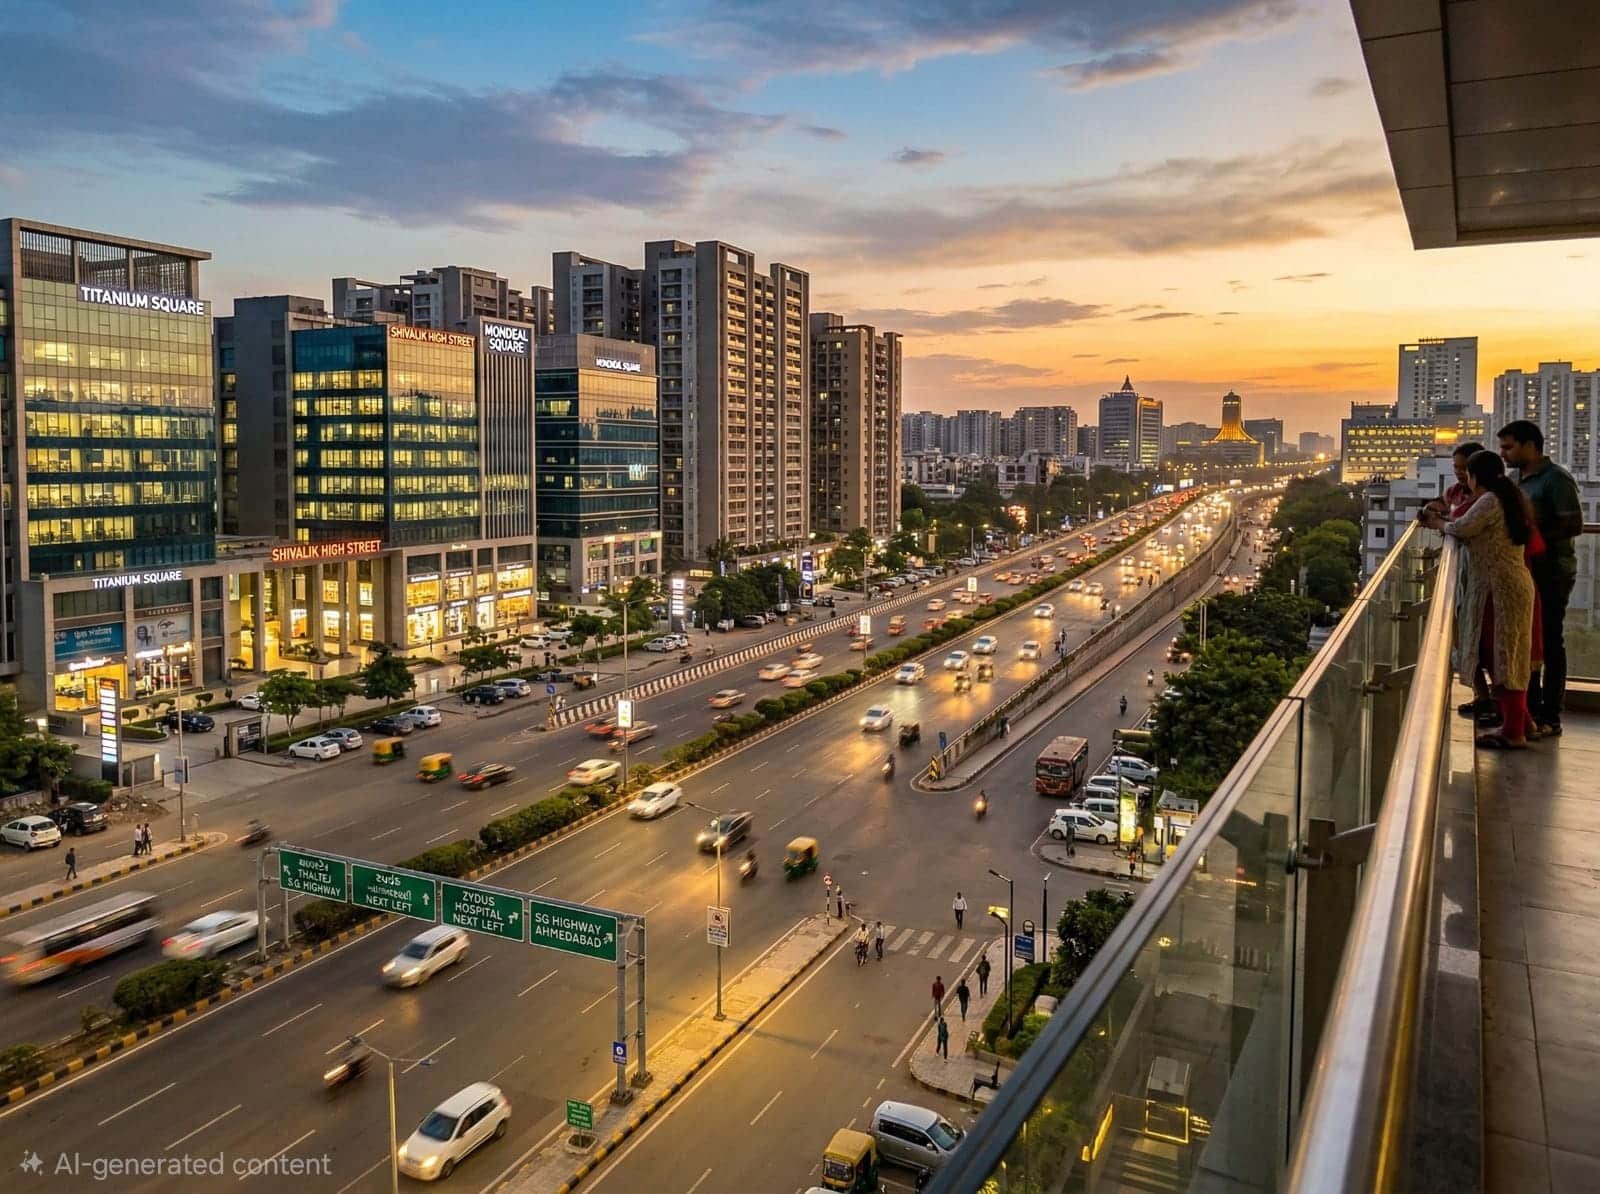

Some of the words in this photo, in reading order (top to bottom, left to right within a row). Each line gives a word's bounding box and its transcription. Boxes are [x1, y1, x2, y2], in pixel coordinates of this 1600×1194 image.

[81, 286, 148, 309] TITANIUM
[151, 295, 205, 315] SQUARE
[391, 326, 428, 341] SHIVALIK
[428, 331, 448, 343] HIGH
[449, 334, 475, 347] STREET
[484, 324, 529, 342] MONDEAL
[488, 338, 525, 353] SQUARE
[272, 545, 319, 561] SHIVALIK
[321, 542, 345, 557] HIGH
[347, 539, 381, 554] STREET
[92, 574, 141, 590] TITANIUM
[143, 570, 183, 585] SQUARE
[298, 869, 332, 884] THALTEJ
[303, 880, 341, 897] HIGHWAY
[462, 890, 495, 906] ZYDUS
[365, 894, 389, 908] NEXT
[391, 899, 413, 913] LEFT
[455, 902, 503, 921] HOSPITAL
[452, 913, 478, 928] NEXT
[481, 919, 505, 933] LEFT
[535, 912, 549, 925] SG
[552, 915, 602, 936] HIGHWAY
[535, 925, 602, 948] AHMEDABAD
